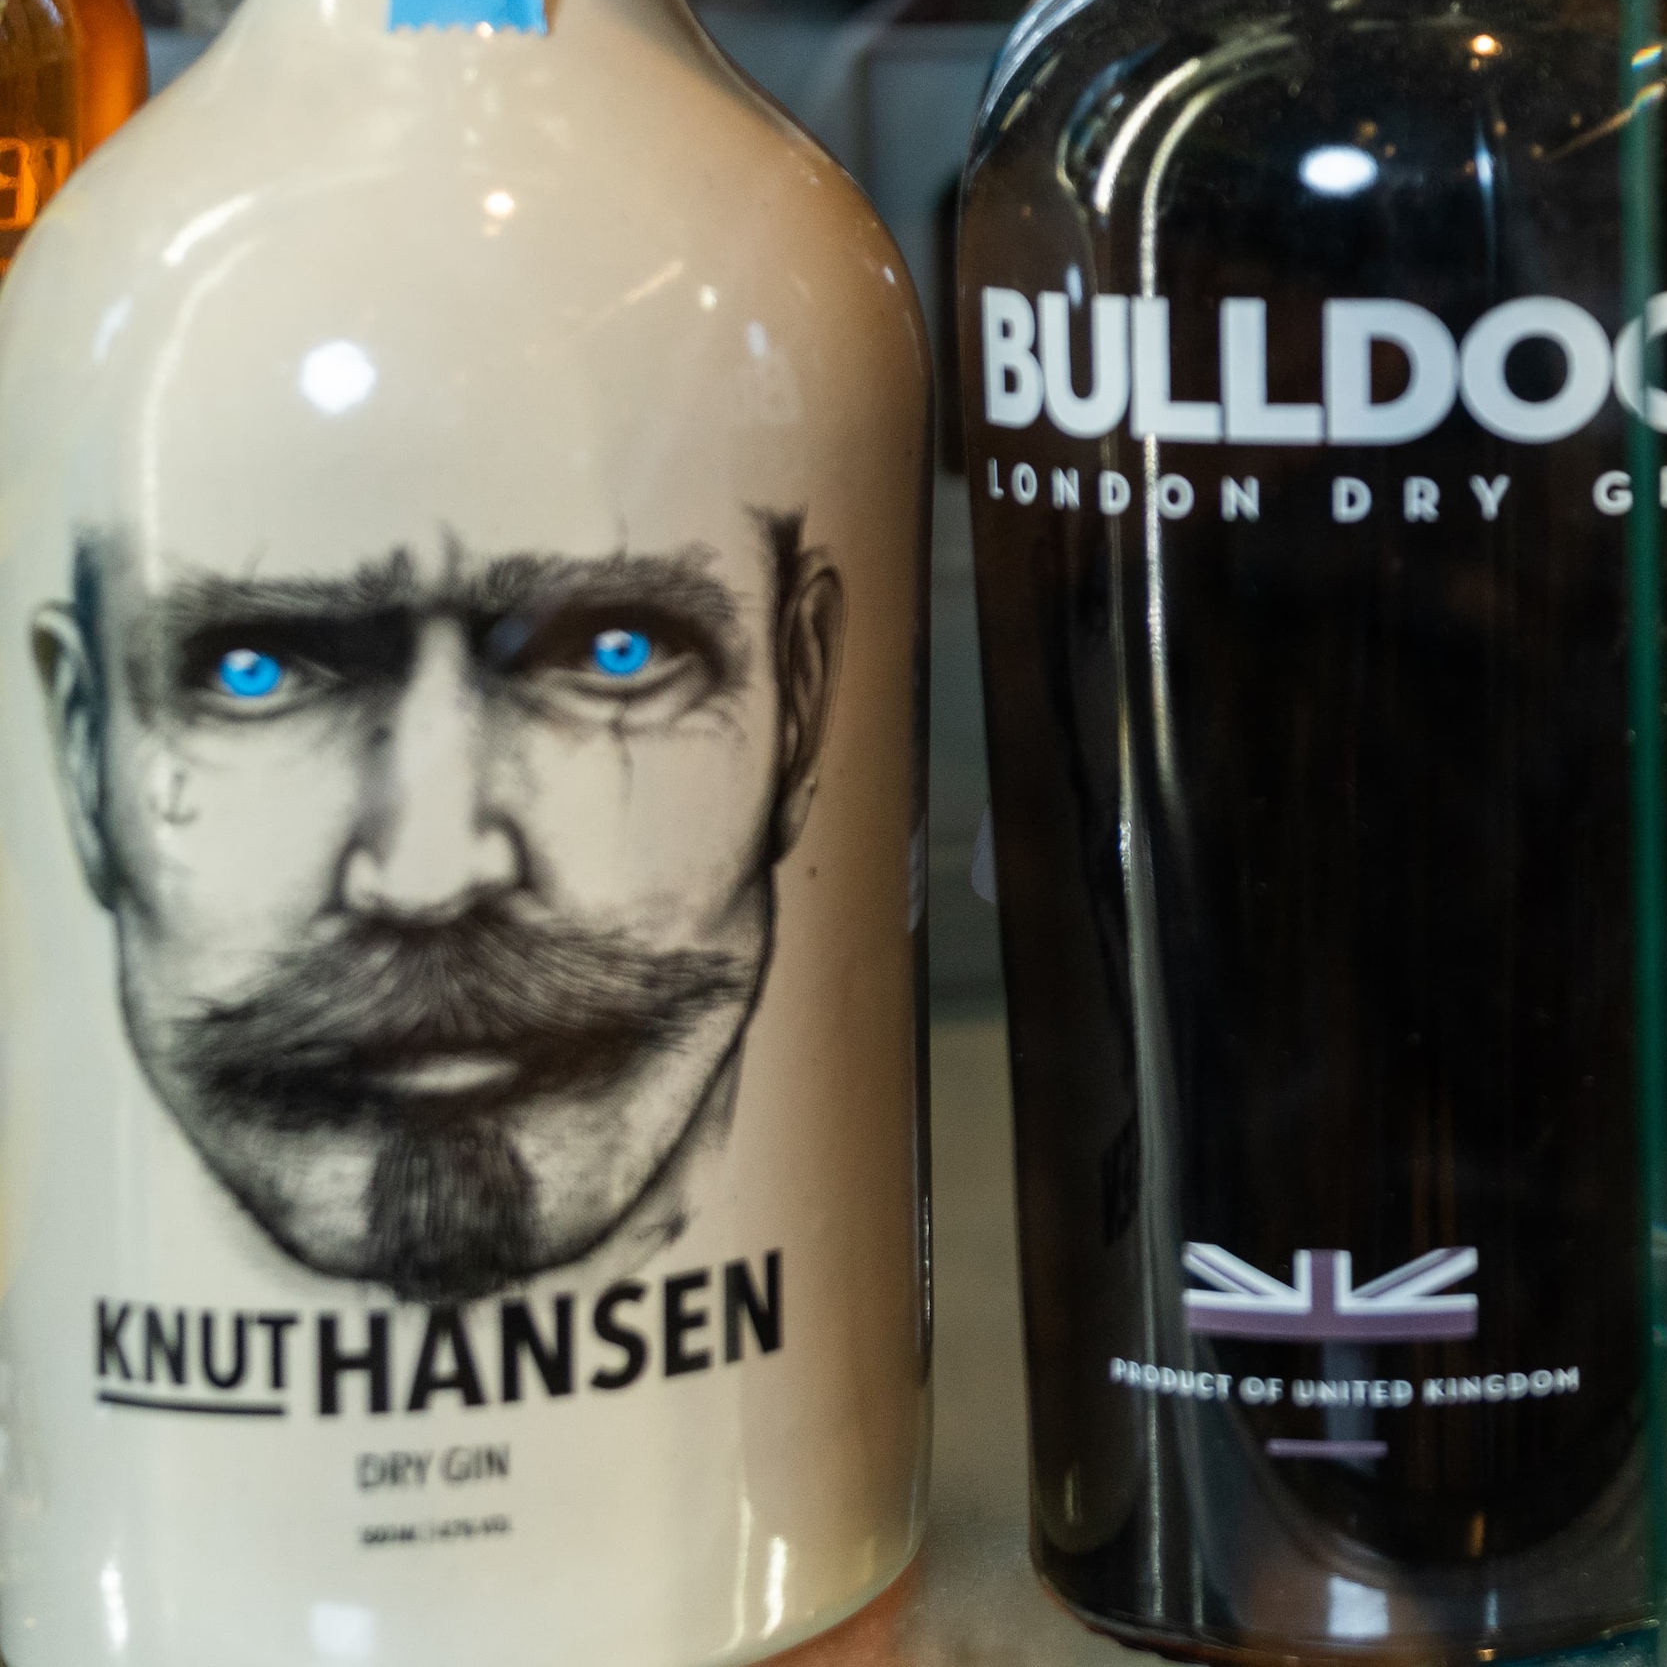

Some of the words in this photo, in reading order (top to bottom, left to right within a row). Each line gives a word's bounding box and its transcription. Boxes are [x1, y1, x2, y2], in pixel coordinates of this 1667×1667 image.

[988, 458, 1261, 524] LONDON
[1333, 474, 1512, 524] DRY
[94, 1298, 299, 1391] KNUT
[317, 1249, 784, 1418] HANSEN
[1108, 1355, 1233, 1404] PRODUCT
[1238, 1374, 1285, 1406] OF
[1291, 1378, 1414, 1409] UNITED
[1422, 1365, 1581, 1406] KINGDOM
[359, 1449, 433, 1494] DRY
[439, 1442, 511, 1489] GIN
